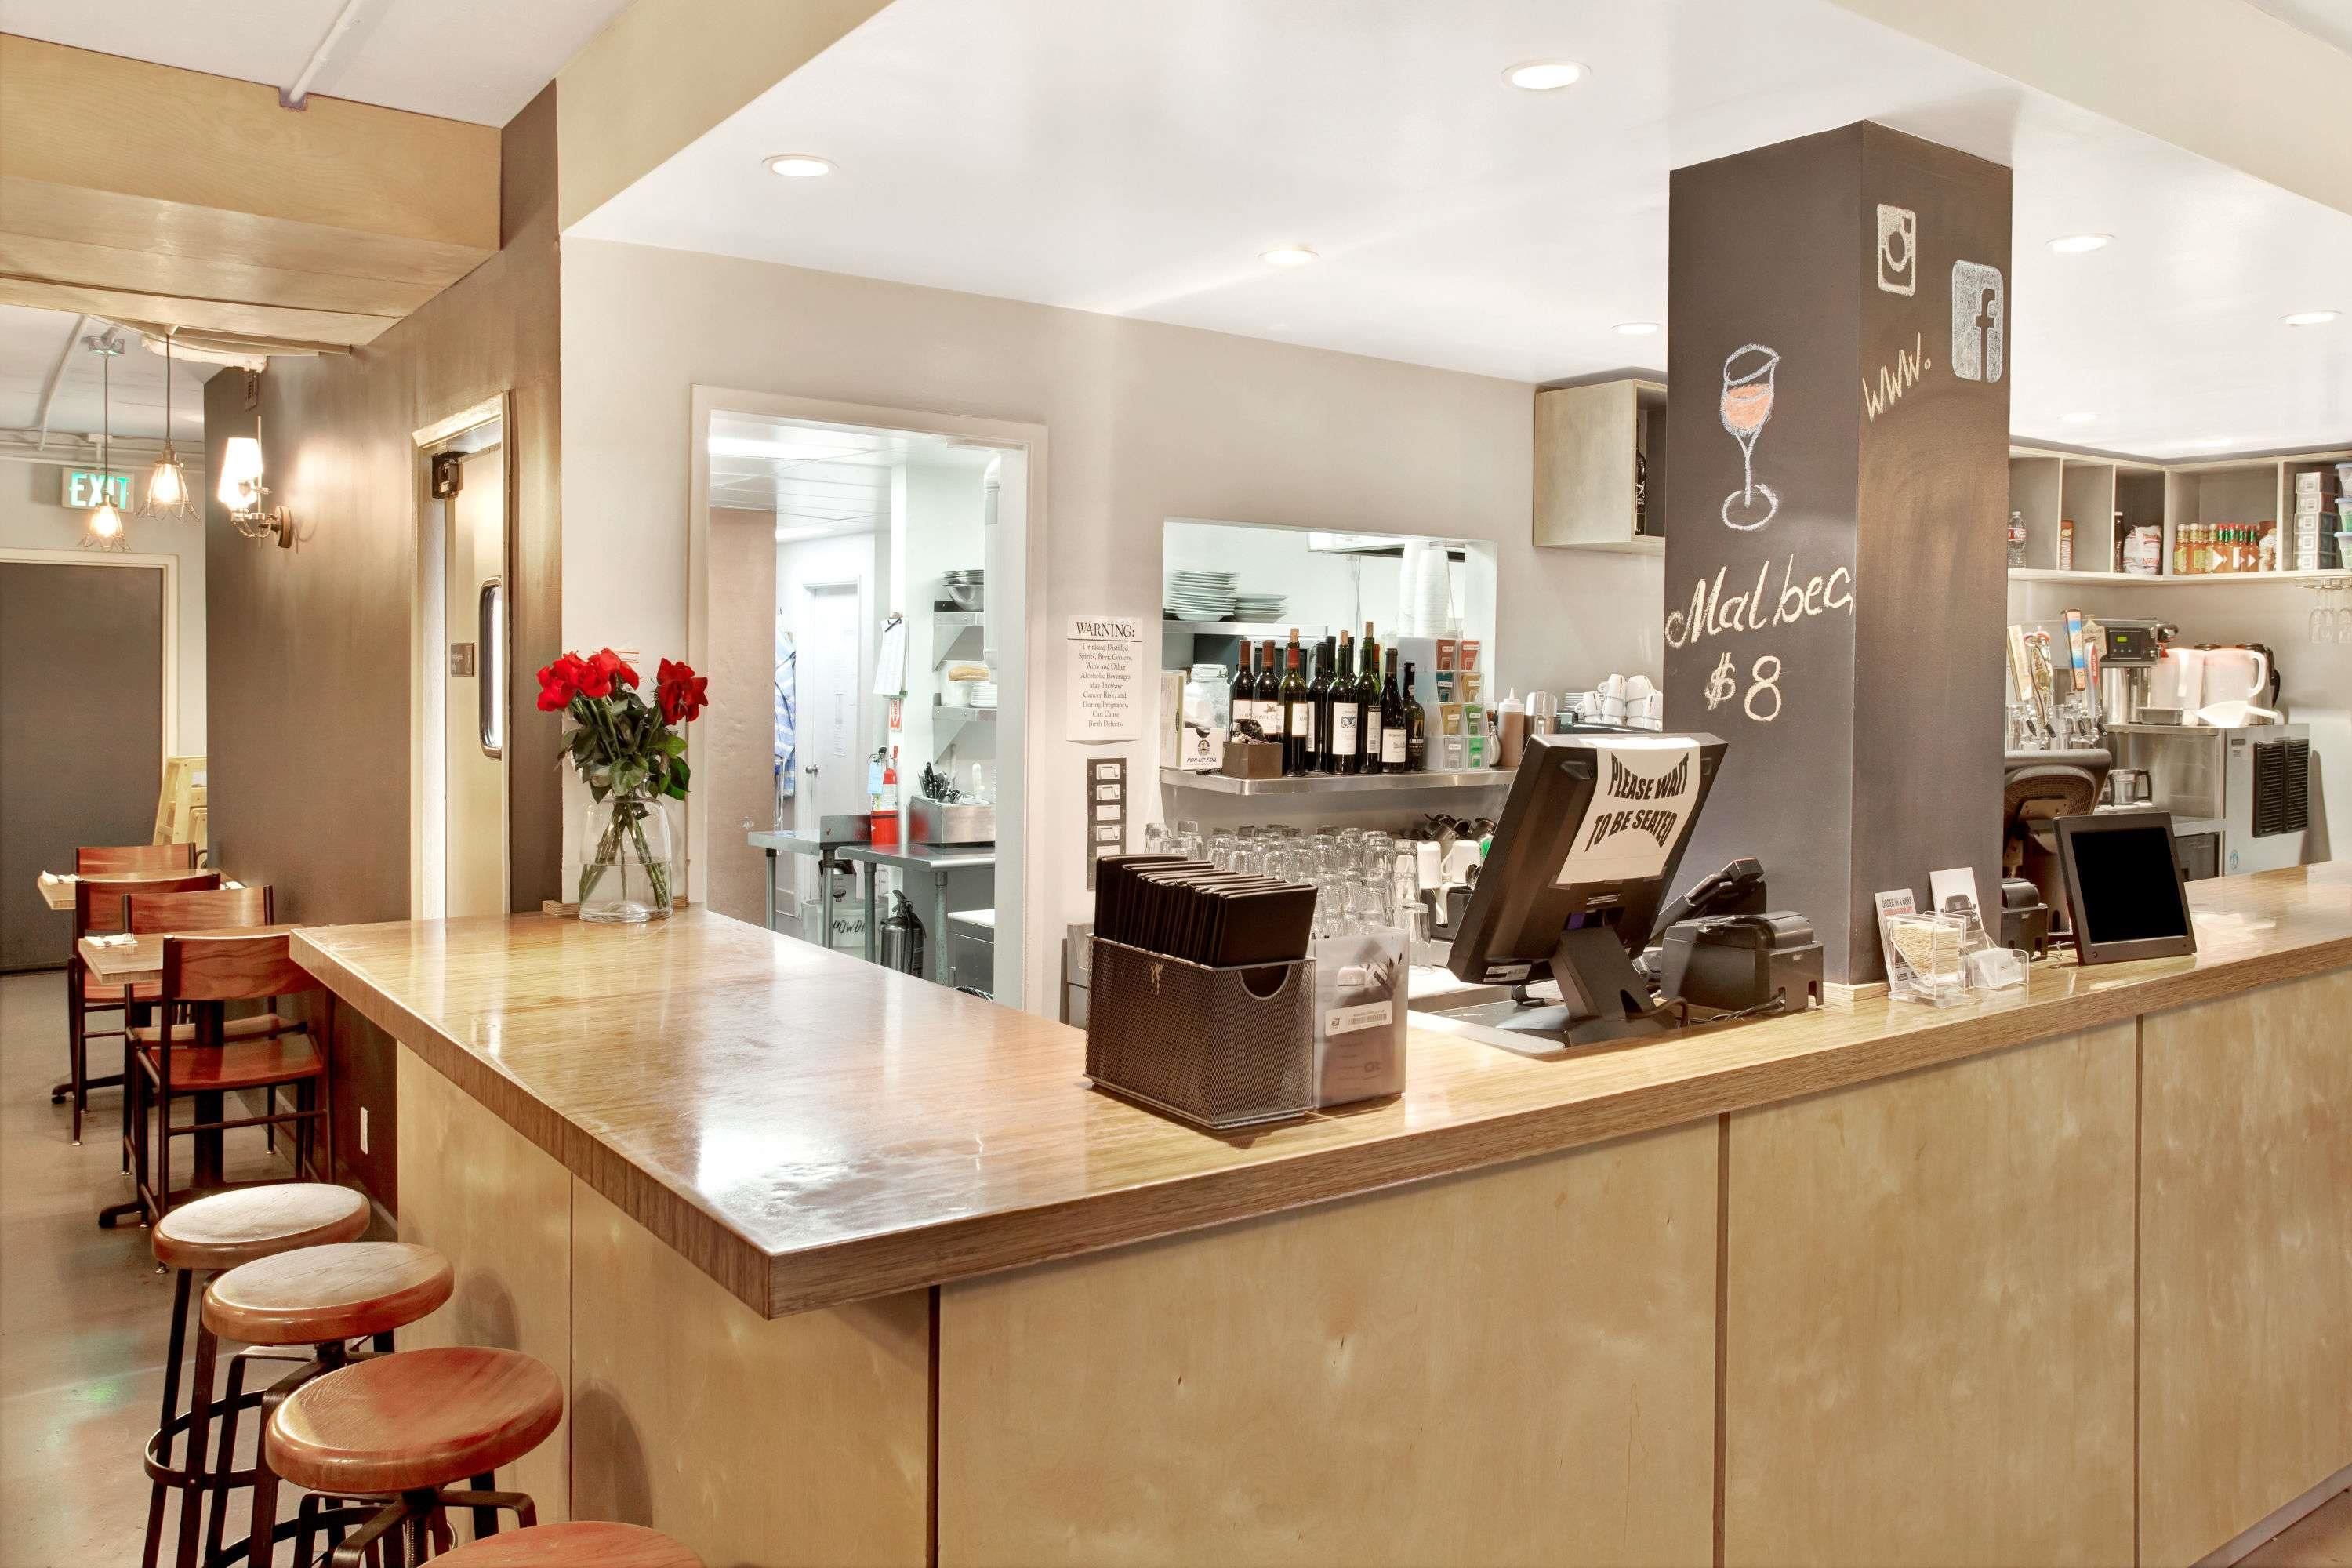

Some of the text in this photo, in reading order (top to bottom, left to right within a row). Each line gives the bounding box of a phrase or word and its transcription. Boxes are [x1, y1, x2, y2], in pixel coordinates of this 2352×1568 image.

[70, 472, 131, 510] EXIT
[1076, 622, 1134, 637] WARNING:
[1607, 751, 1690, 800] PLEASE WAIT
[1584, 809, 1678, 853] TO BE SEATED
[833, 920, 865, 934] POWD
